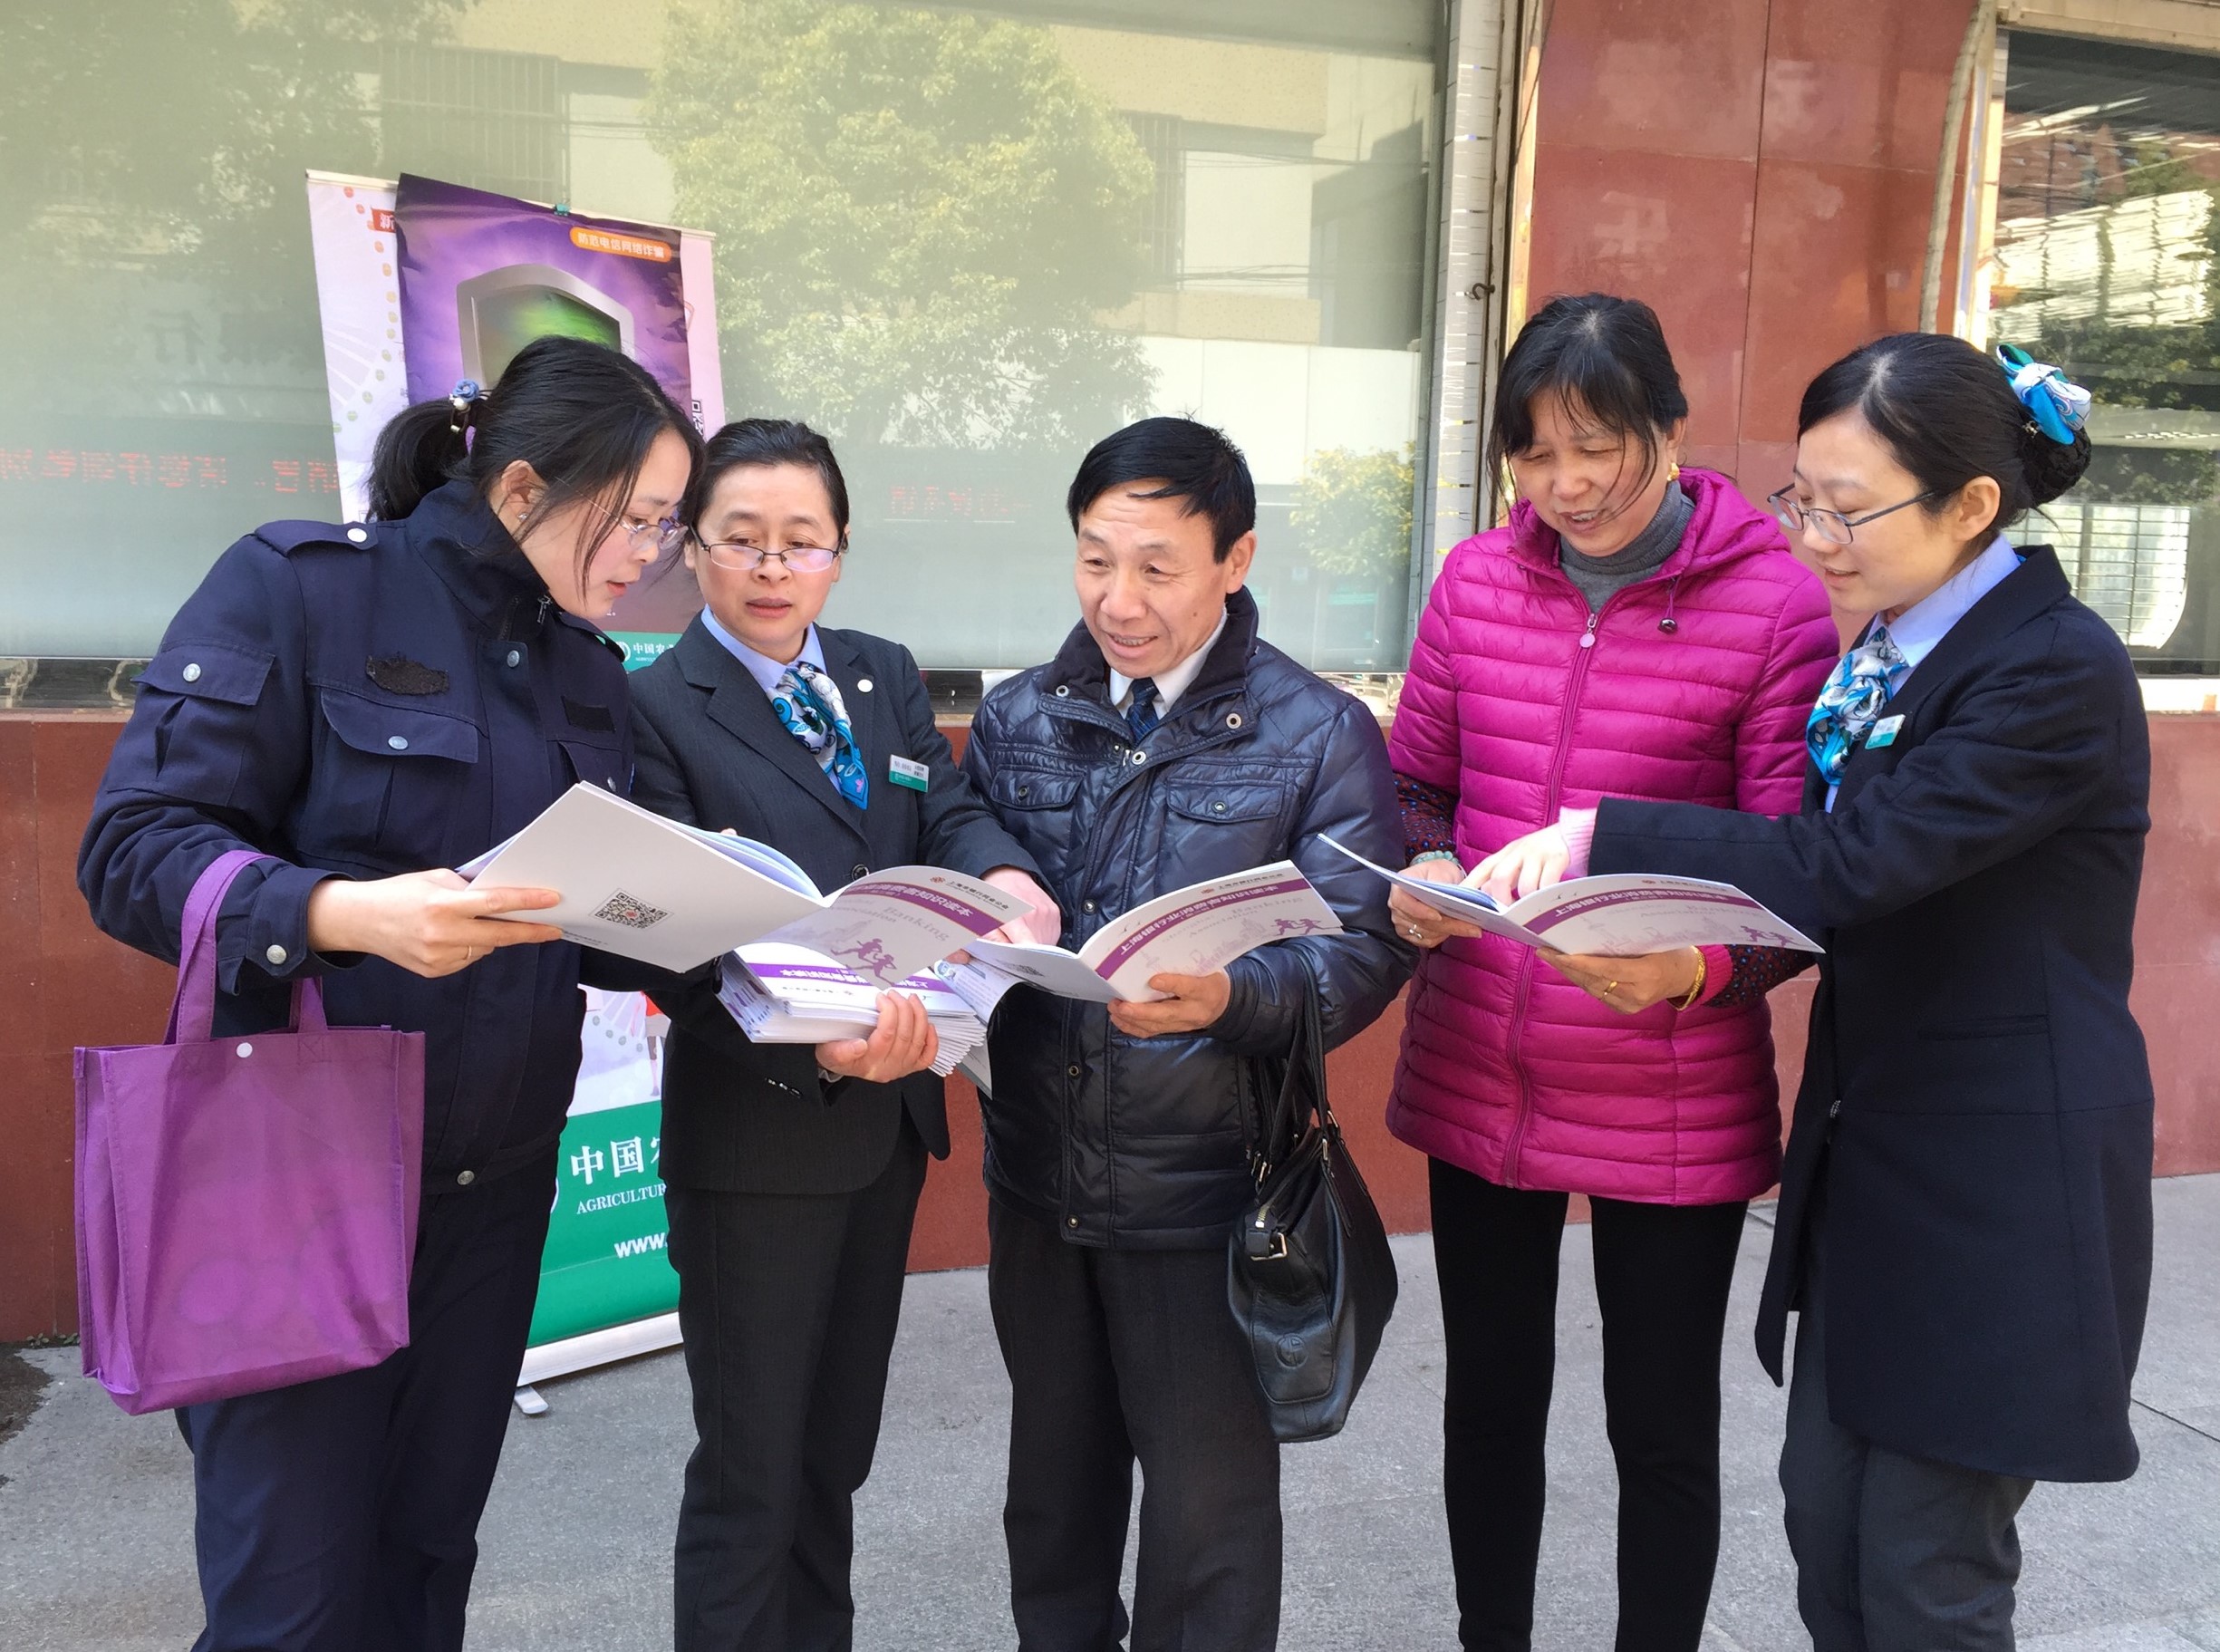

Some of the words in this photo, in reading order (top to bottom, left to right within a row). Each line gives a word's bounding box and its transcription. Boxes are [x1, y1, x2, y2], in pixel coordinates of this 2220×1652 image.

[577, 232, 665, 258] 防范电信网络诈骗
[883, 907, 950, 942] Banking
